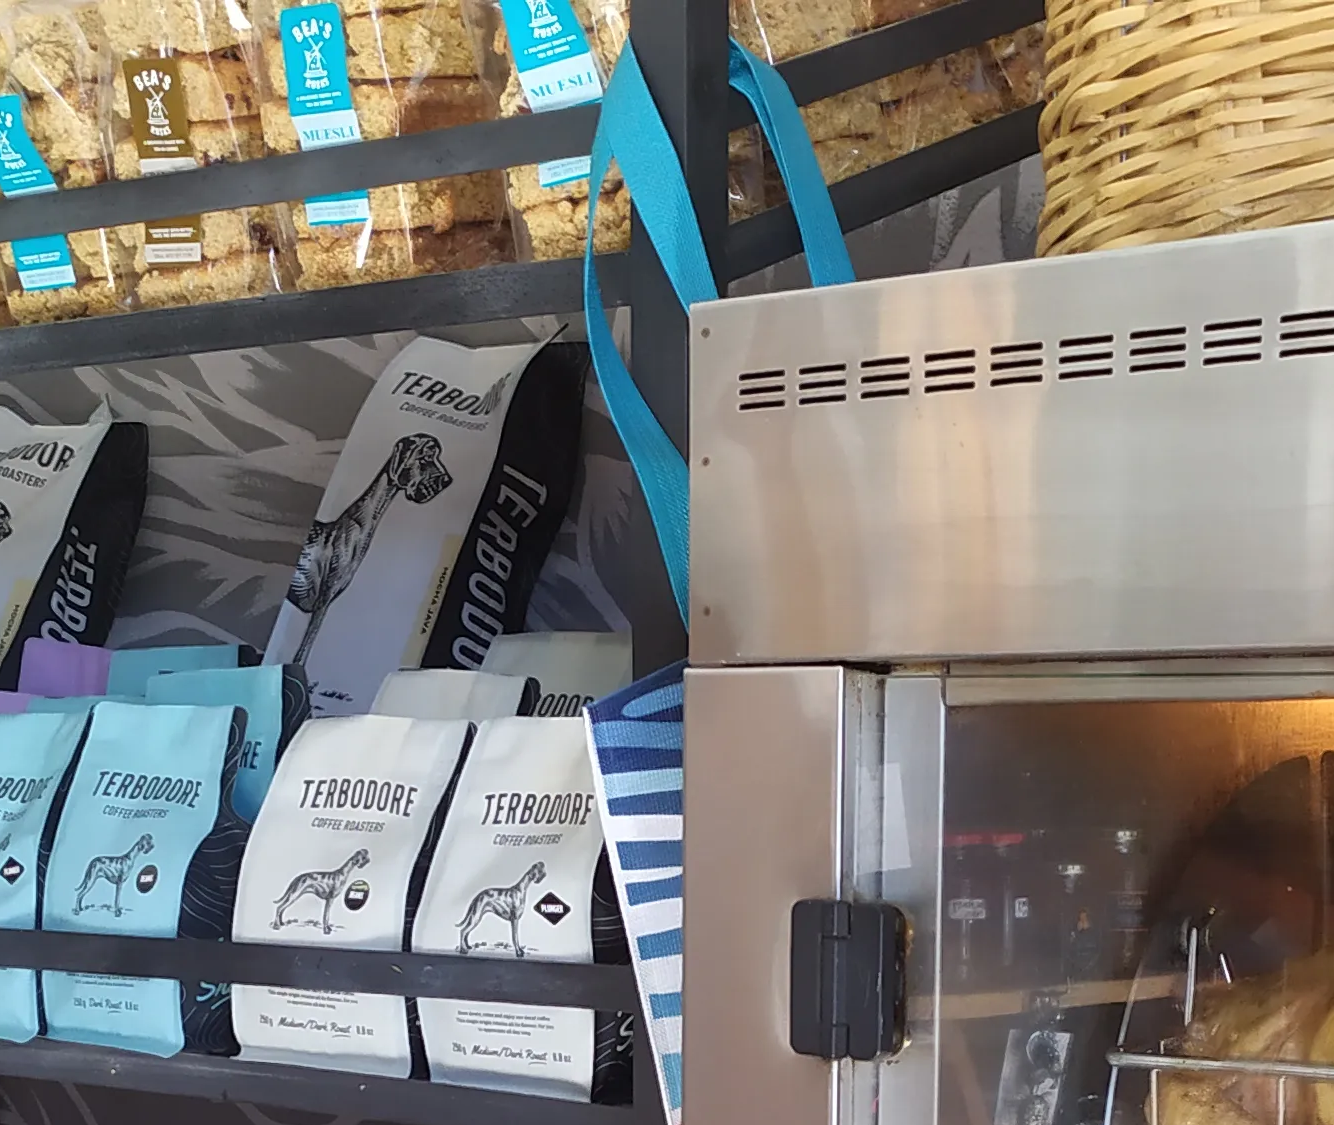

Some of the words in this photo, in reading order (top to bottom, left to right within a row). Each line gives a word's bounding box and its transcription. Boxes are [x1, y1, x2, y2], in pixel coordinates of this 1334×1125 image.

[292, 18, 332, 43] BEA'S
[133, 69, 172, 92] BEA'S
[531, 72, 594, 98] MUESLI
[302, 125, 356, 142] MUESLI
[399, 401, 437, 420] COFFEE
[92, 770, 203, 809] TERBODORE
[299, 778, 418, 818] TERBODORE
[102, 804, 133, 818] COFFEE
[311, 816, 342, 832] COFFEE
[342, 820, 386, 833] ROASTERS
[492, 833, 524, 846] COFFEE
[523, 833, 563, 846] ROASTERS
[540, 903, 564, 914] PLUNGER
